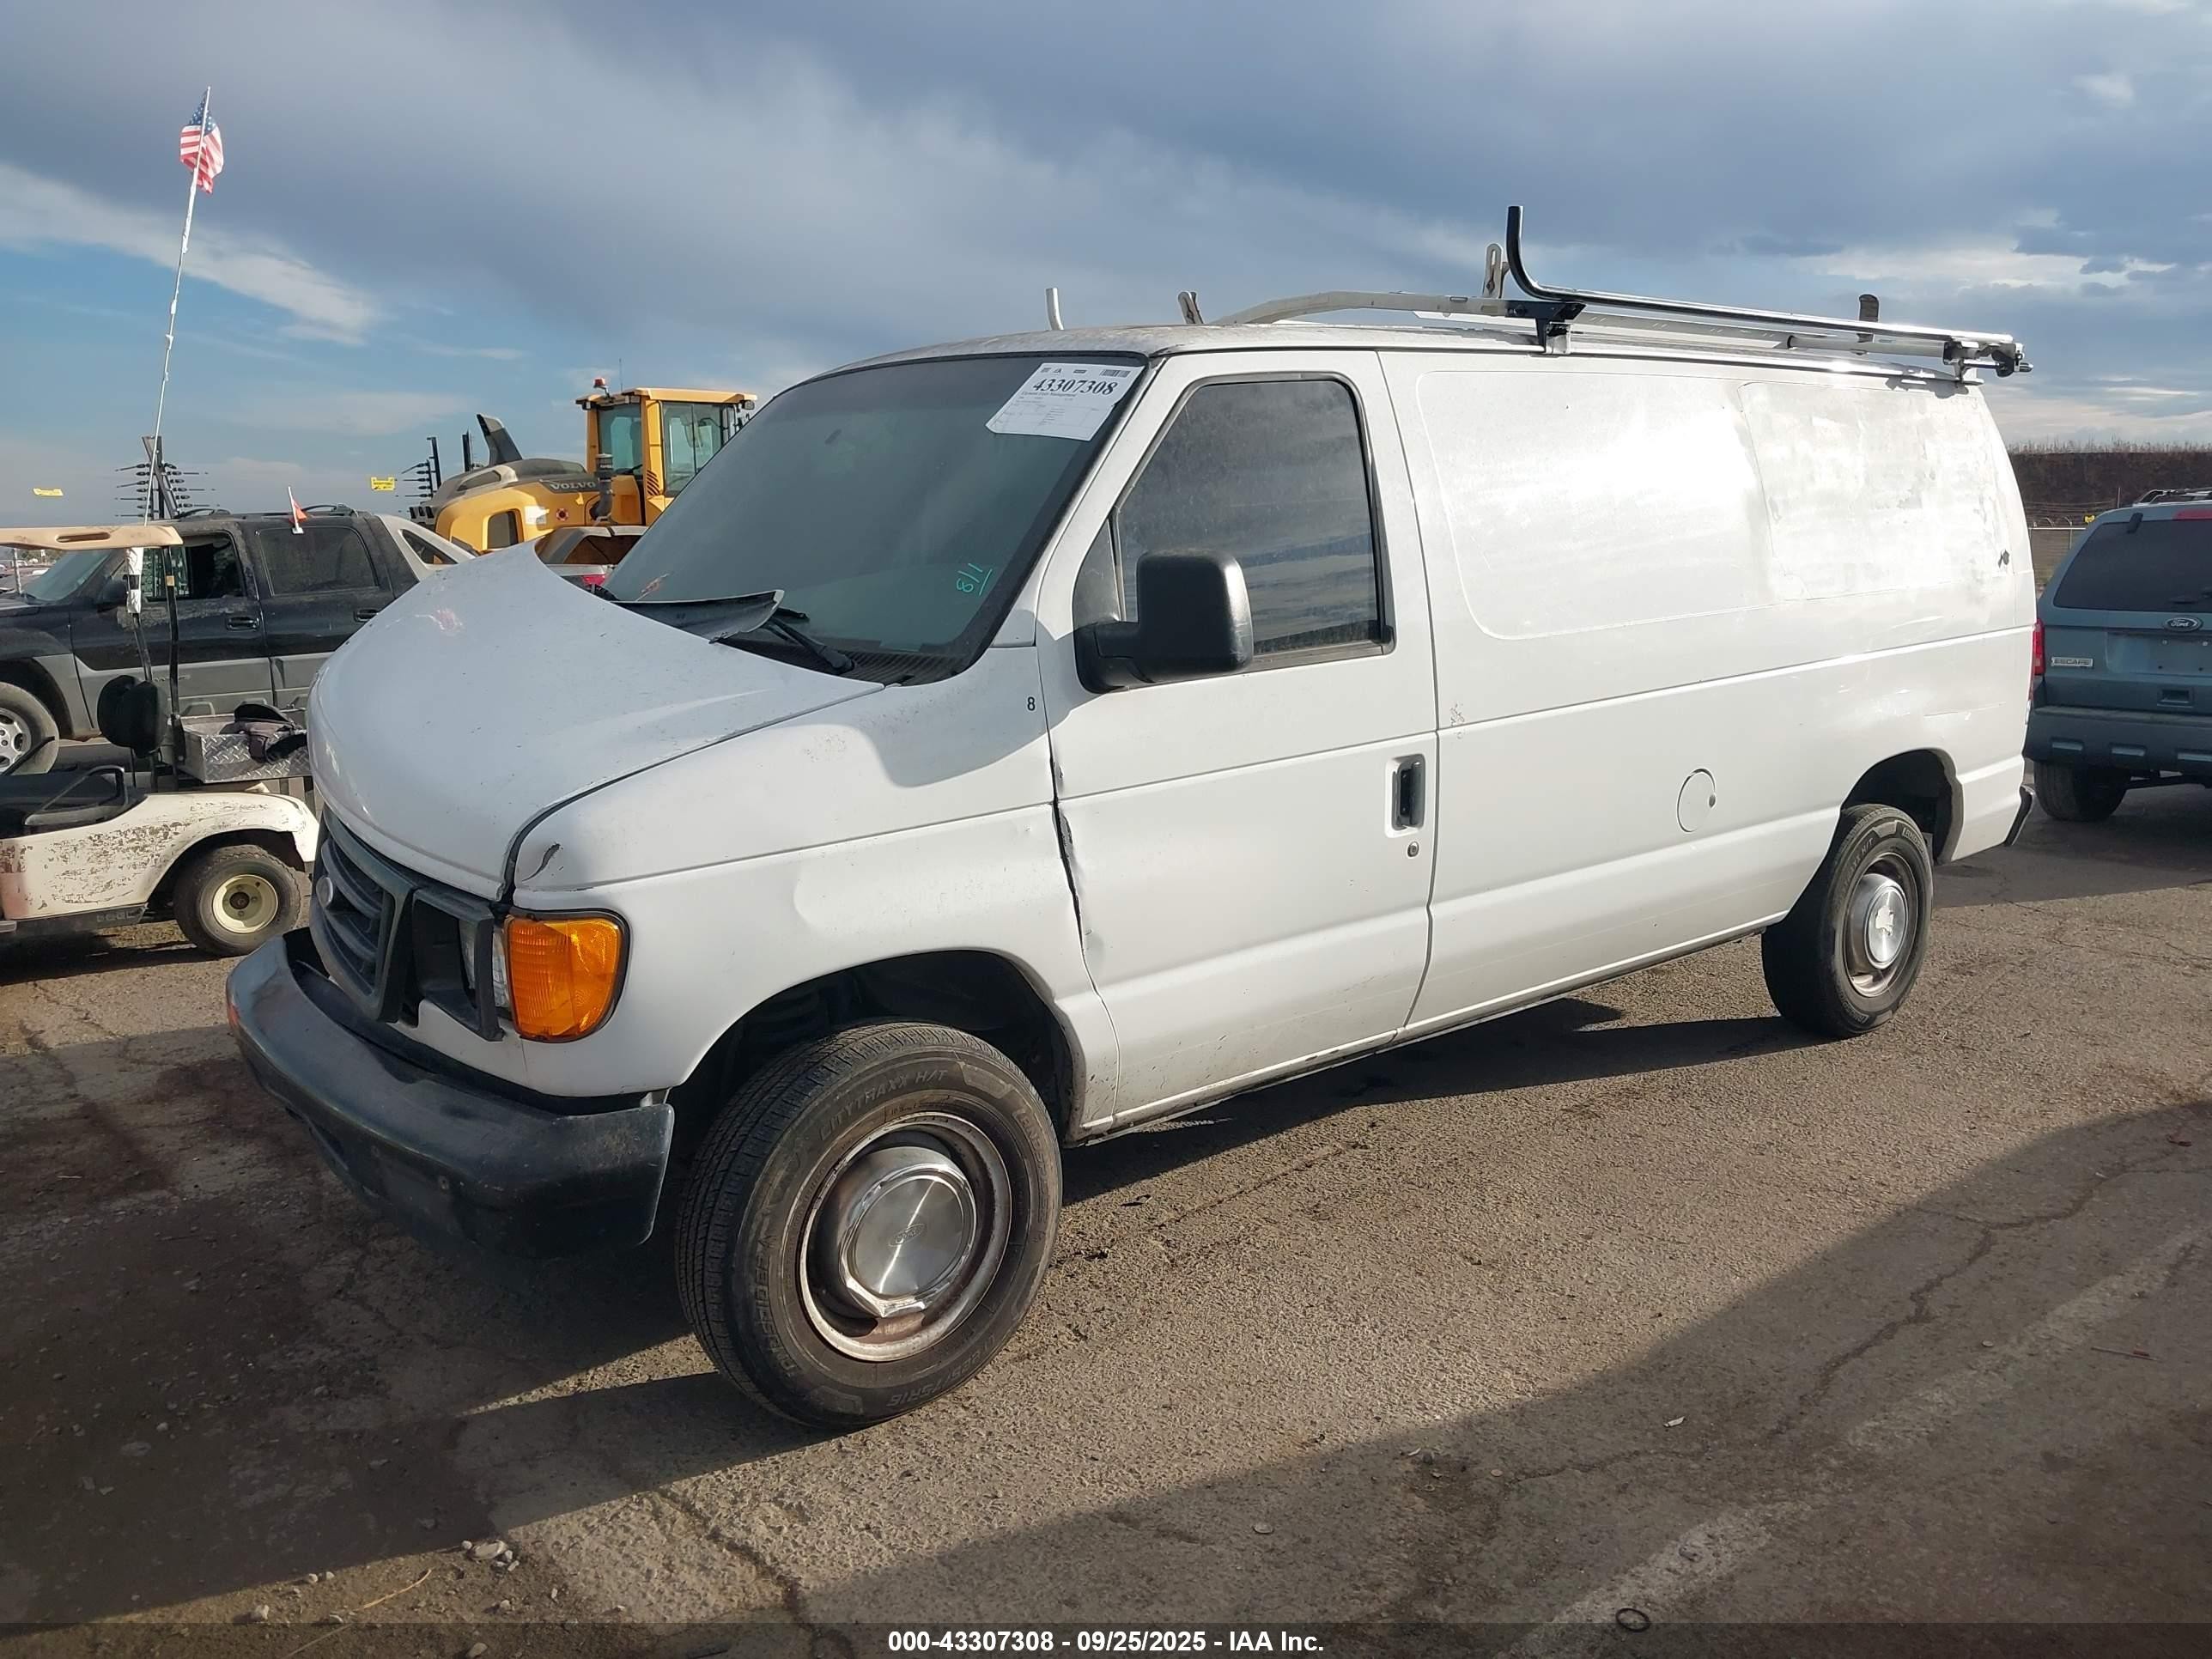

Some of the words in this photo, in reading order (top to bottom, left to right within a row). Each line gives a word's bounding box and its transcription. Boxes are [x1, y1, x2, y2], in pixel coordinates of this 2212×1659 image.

[1033, 378, 1117, 395] 43307308
[550, 481, 596, 489] VOLVO
[2053, 658, 2090, 666] ESCAPE
[1027, 696, 1036, 712] 8
[915, 1070, 948, 1084] H/T
